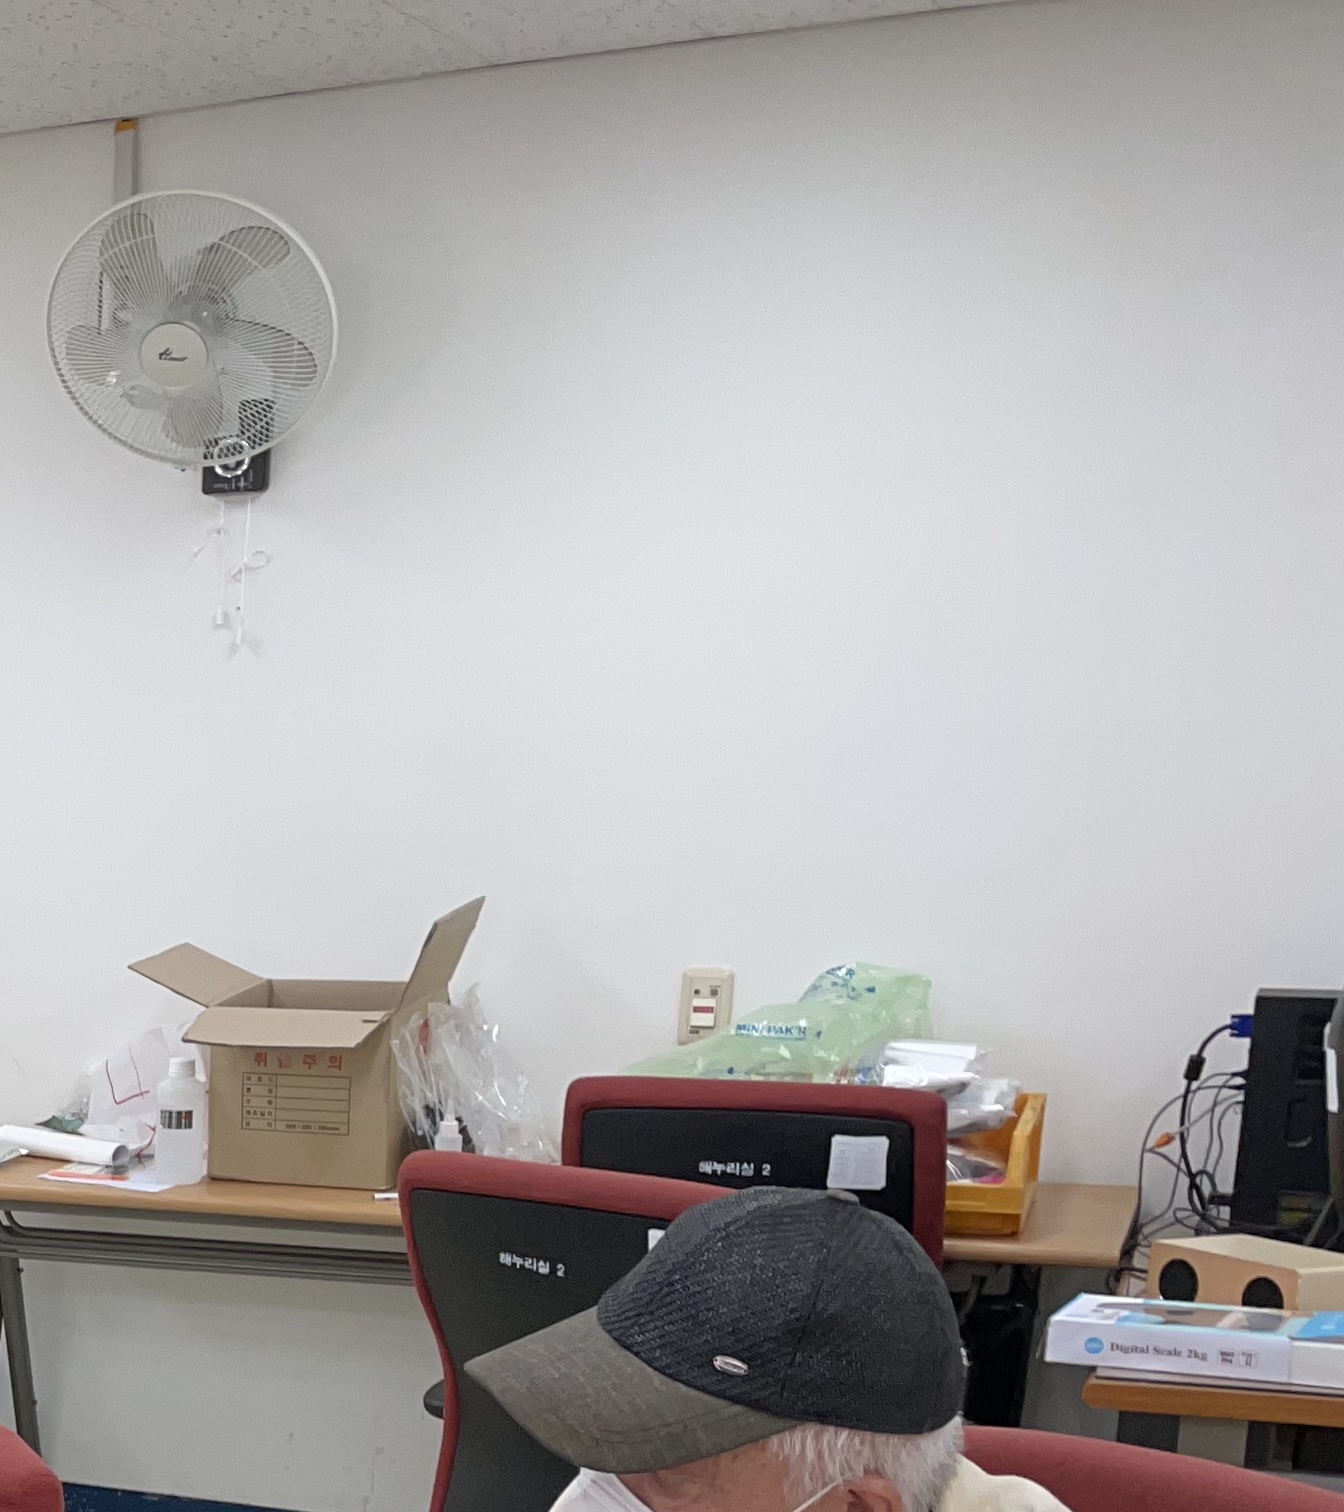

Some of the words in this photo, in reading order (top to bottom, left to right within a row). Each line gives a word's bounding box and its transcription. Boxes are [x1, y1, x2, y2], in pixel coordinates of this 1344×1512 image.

[761, 1162, 772, 1177] 2
[555, 1262, 566, 1278] 2
[1110, 1342, 1150, 1355] Digital
[1153, 1345, 1183, 1358] Scale
